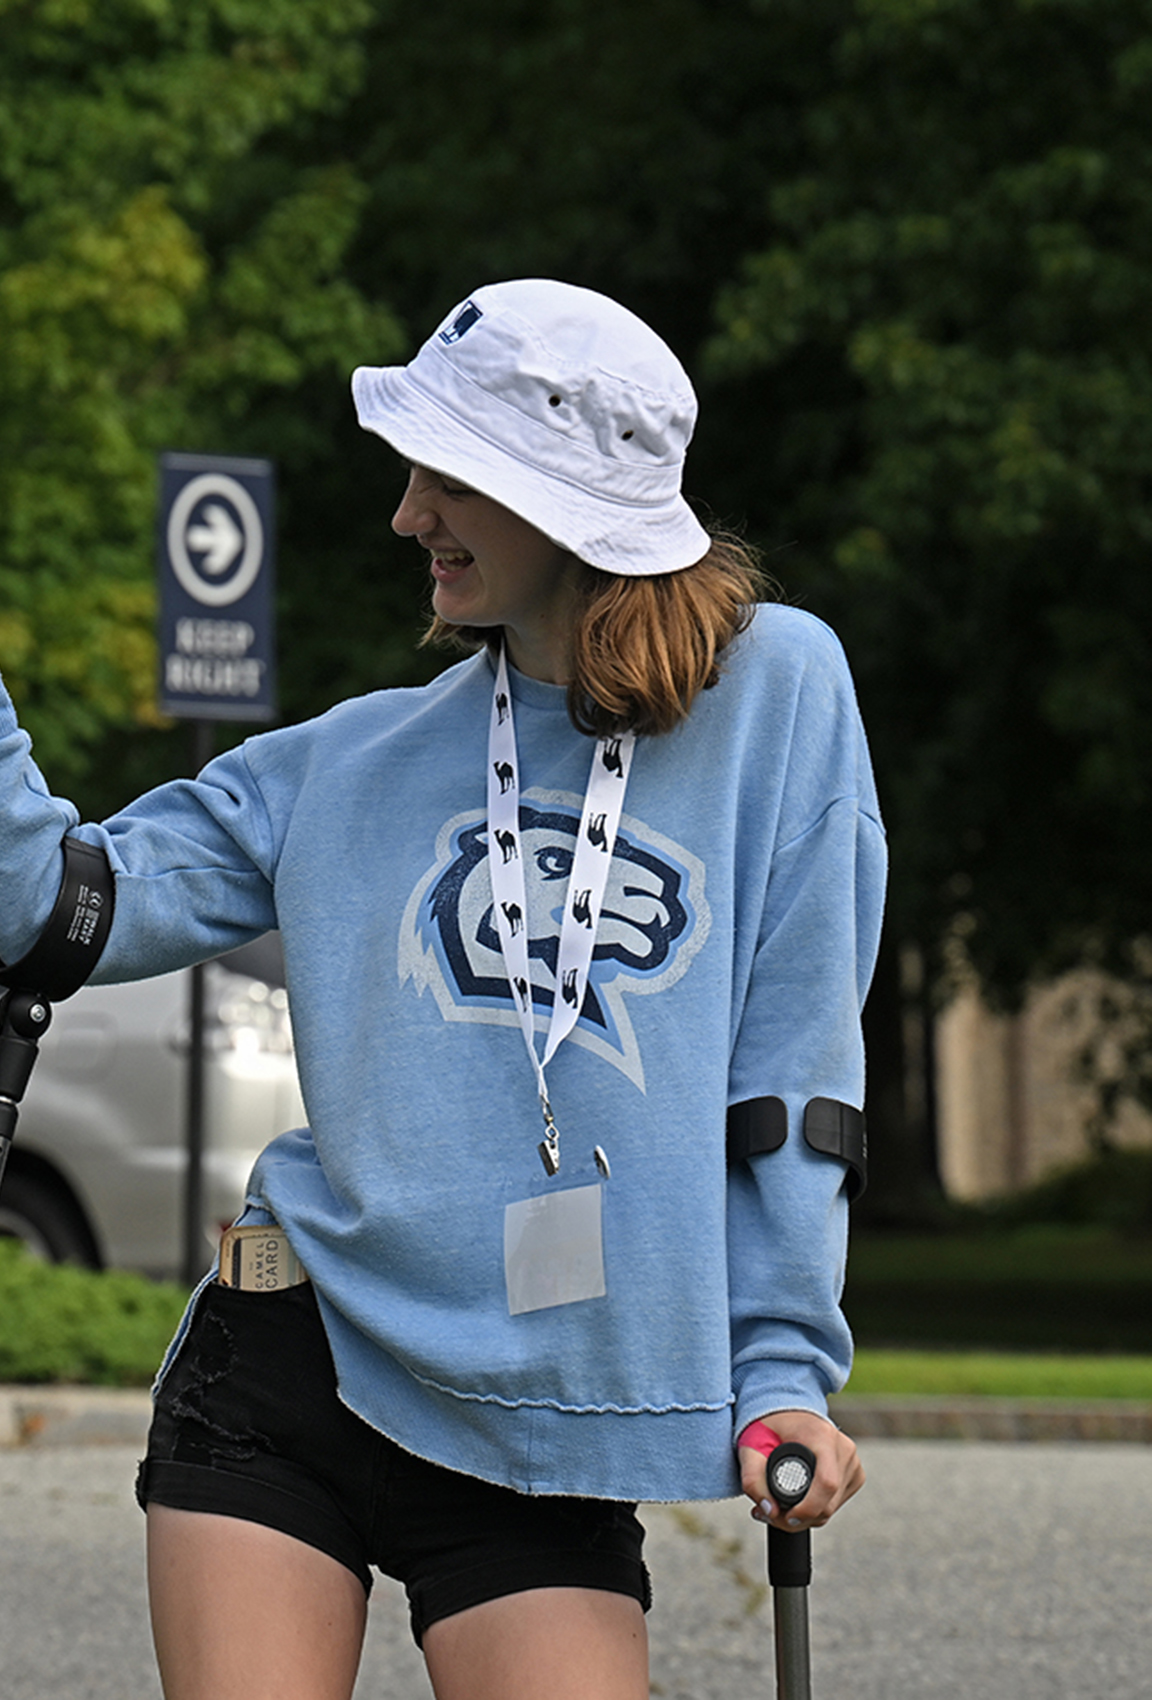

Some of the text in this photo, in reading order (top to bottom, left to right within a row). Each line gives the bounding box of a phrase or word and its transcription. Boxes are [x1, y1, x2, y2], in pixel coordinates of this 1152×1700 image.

[176, 618, 254, 656] KEEP
[166, 655, 263, 696] RIGHT
[255, 1242, 264, 1289] CAMEL
[265, 1240, 279, 1289] CARD
